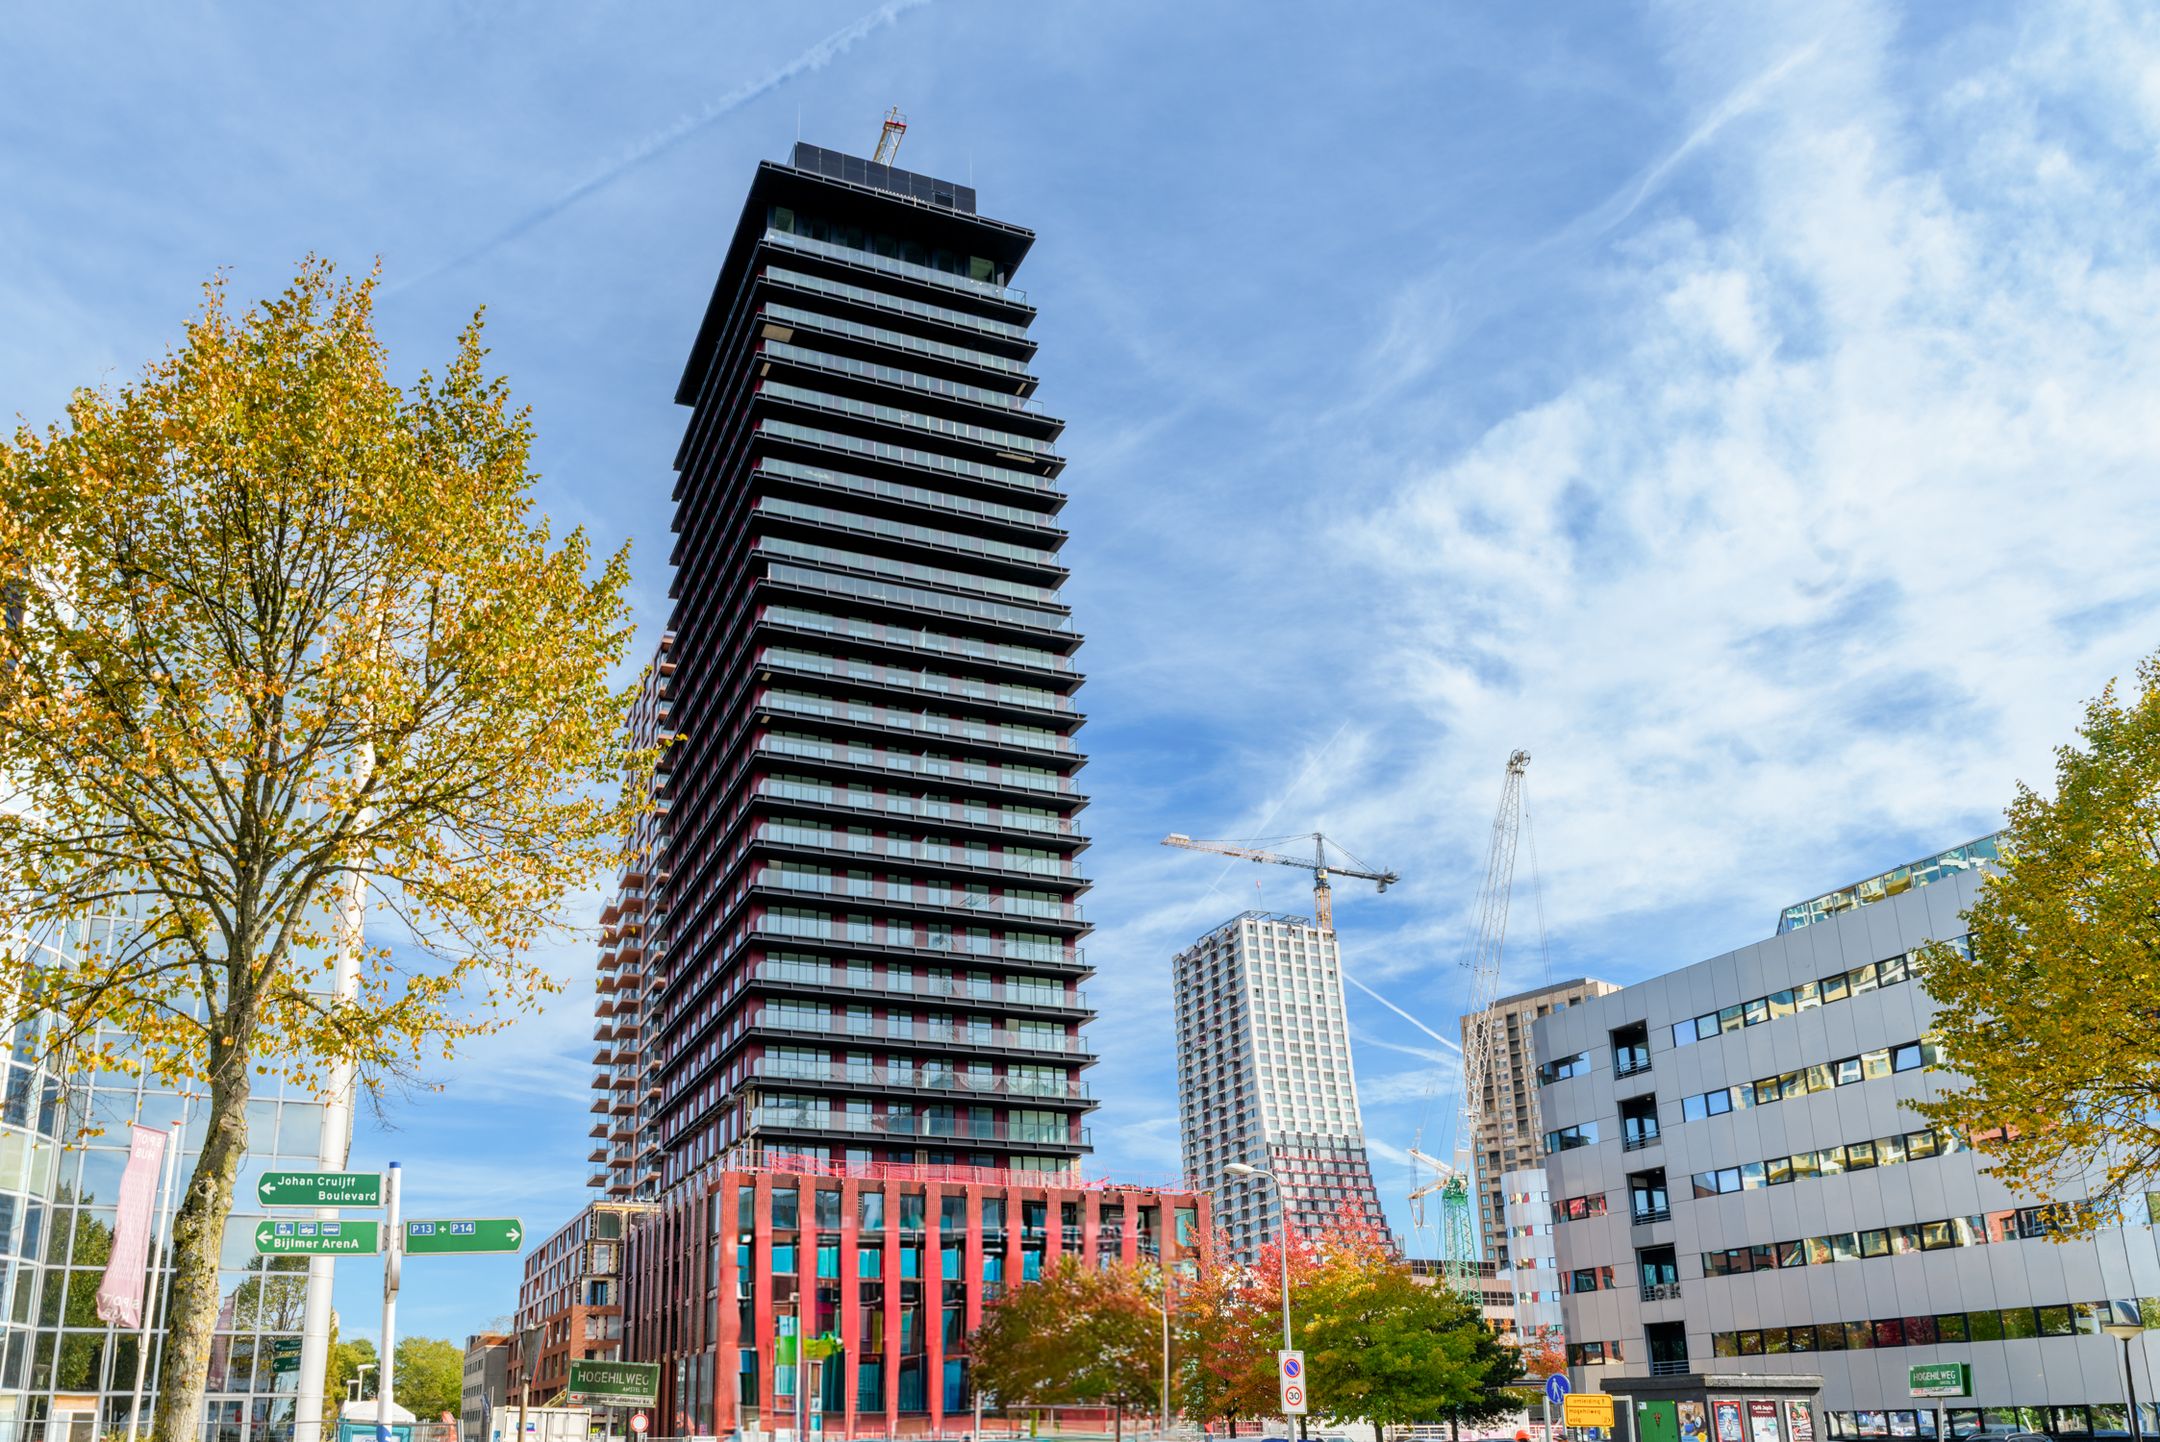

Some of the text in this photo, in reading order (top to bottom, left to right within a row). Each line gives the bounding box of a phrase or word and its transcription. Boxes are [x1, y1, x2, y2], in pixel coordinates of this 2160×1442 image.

[277, 1176, 356, 1189] Johan Cruijff
[318, 1191, 377, 1201] Boulevard
[274, 1238, 359, 1250] Bijlmer ArenA
[577, 1370, 650, 1386] HOGEHILWEG
[1288, 1391, 1300, 1400] 30
